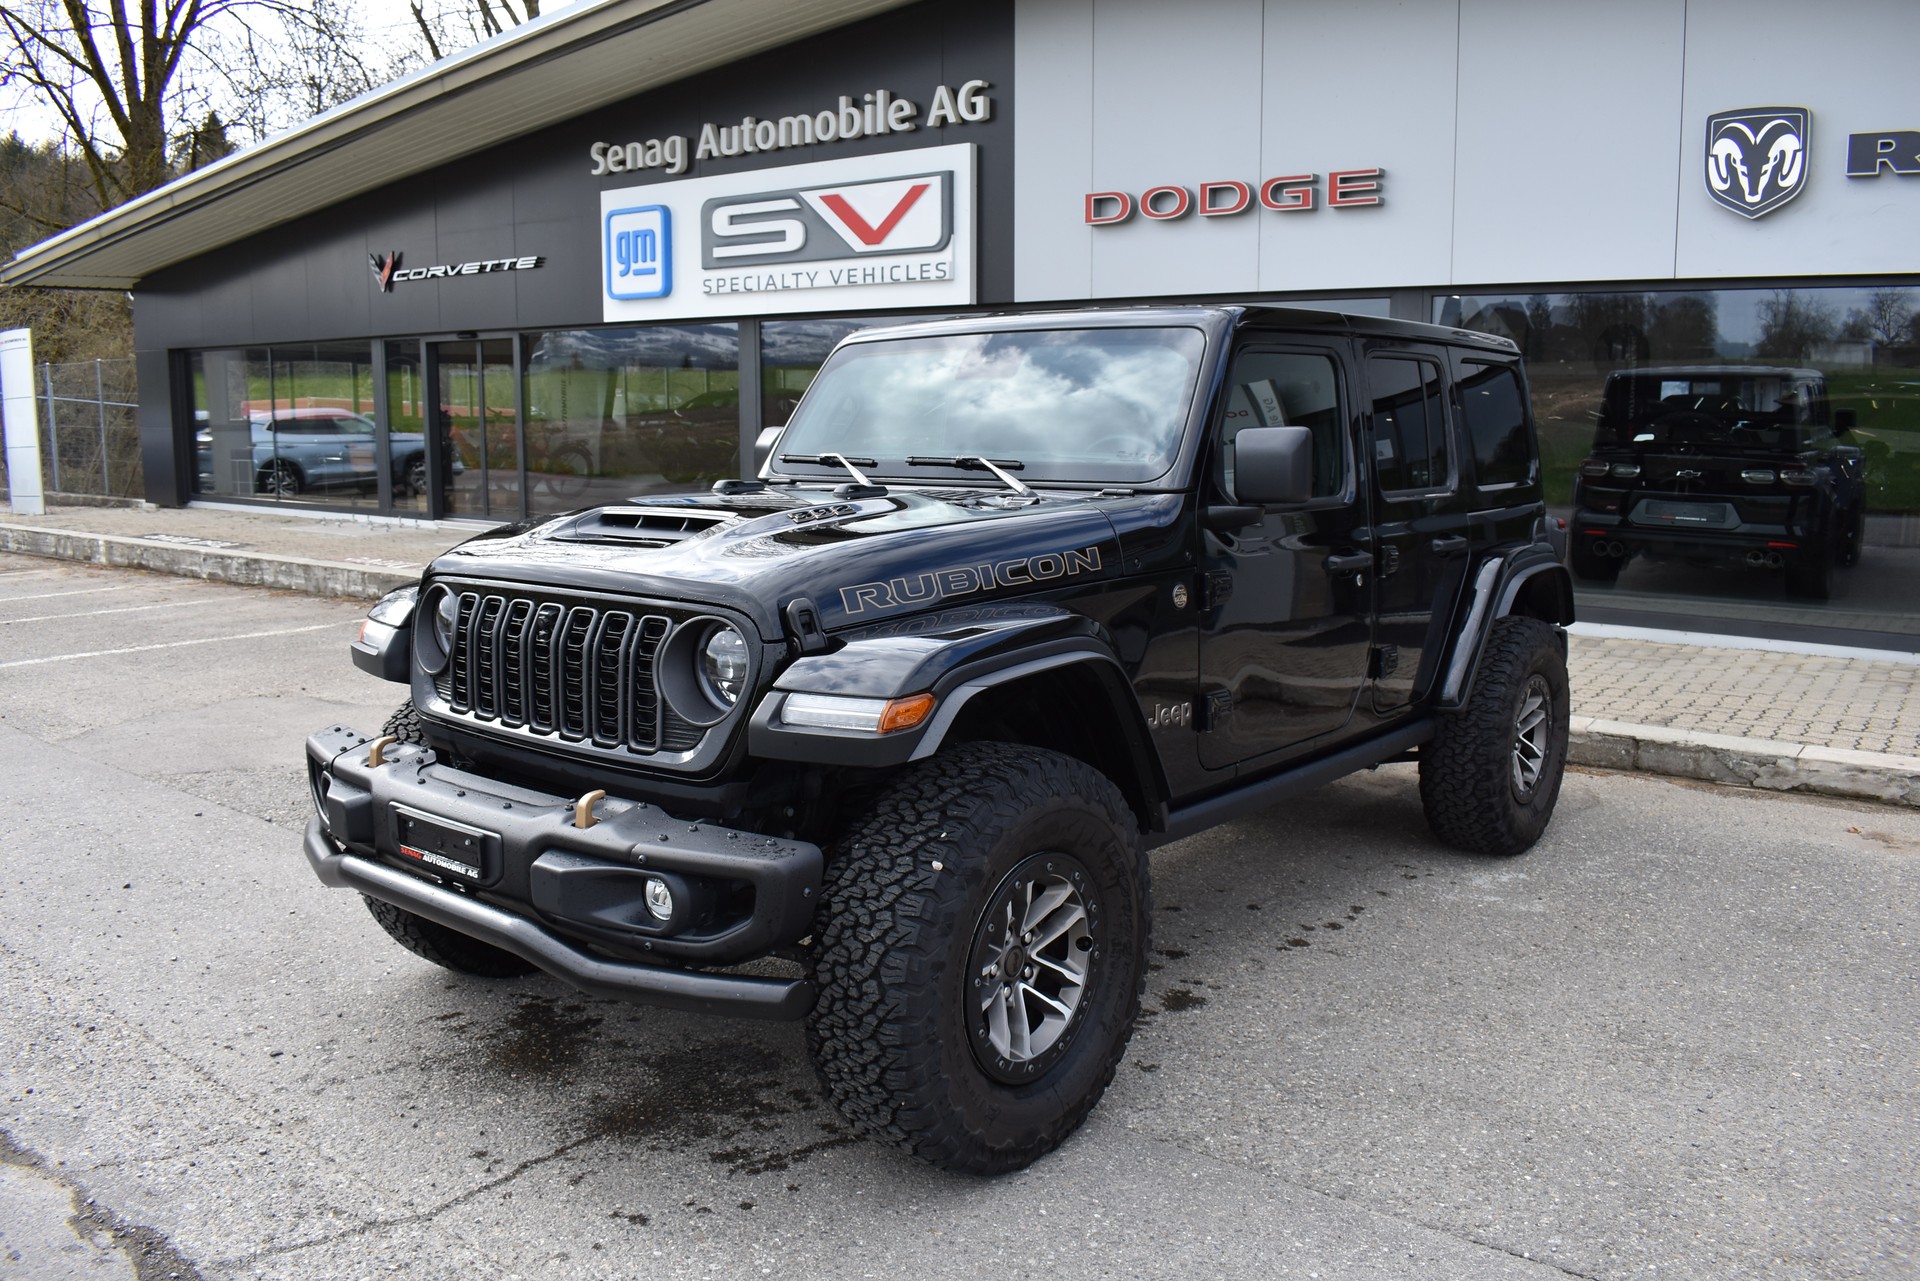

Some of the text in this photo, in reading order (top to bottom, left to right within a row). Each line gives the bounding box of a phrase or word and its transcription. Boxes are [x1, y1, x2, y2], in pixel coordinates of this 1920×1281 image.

[590, 80, 990, 175] Senag Automobile AG
[1084, 167, 1386, 226] DODGE
[392, 256, 538, 282] CORVETTE
[616, 228, 657, 276] gm
[703, 262, 948, 294] SPECIALTY VEHICLES
[839, 547, 1102, 615] RUBICON
[1148, 702, 1192, 729] Jeep
[400, 846, 479, 879] SENAG AUTOMOBILE AG
